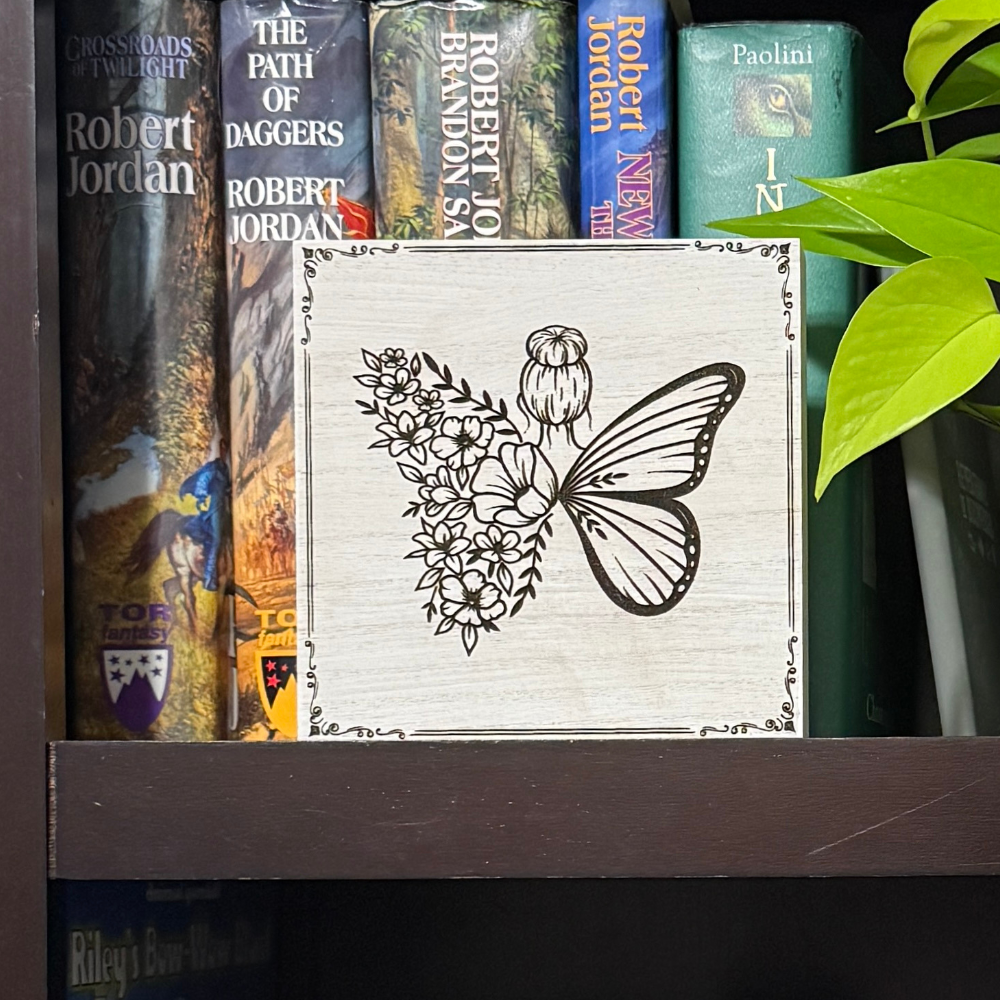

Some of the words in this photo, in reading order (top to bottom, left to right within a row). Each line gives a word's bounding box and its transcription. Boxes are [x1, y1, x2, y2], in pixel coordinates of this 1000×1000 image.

[65, 34, 192, 61] CROSSROADS
[253, 19, 307, 45] THE
[90, 56, 190, 79] TWILIGHT
[248, 53, 314, 80] PATH
[732, 43, 814, 66] Paolini
[587, 15, 618, 134] Jordan
[617, 15, 649, 133] Robert
[262, 86, 300, 113] OF
[440, 31, 470, 187] BRANDON
[469, 31, 500, 183] ROBERT
[65, 105, 196, 152] Robert
[225, 120, 344, 149] DAGGERS
[66, 150, 196, 198] Jordan
[228, 176, 345, 208] ROBERT
[616, 149, 654, 240] NEW
[230, 212, 344, 245] JORDAN
[471, 190, 502, 240] JO
[98, 602, 170, 622] TOR
[103, 624, 170, 644] fantasy
[71, 927, 138, 998] Riley's
